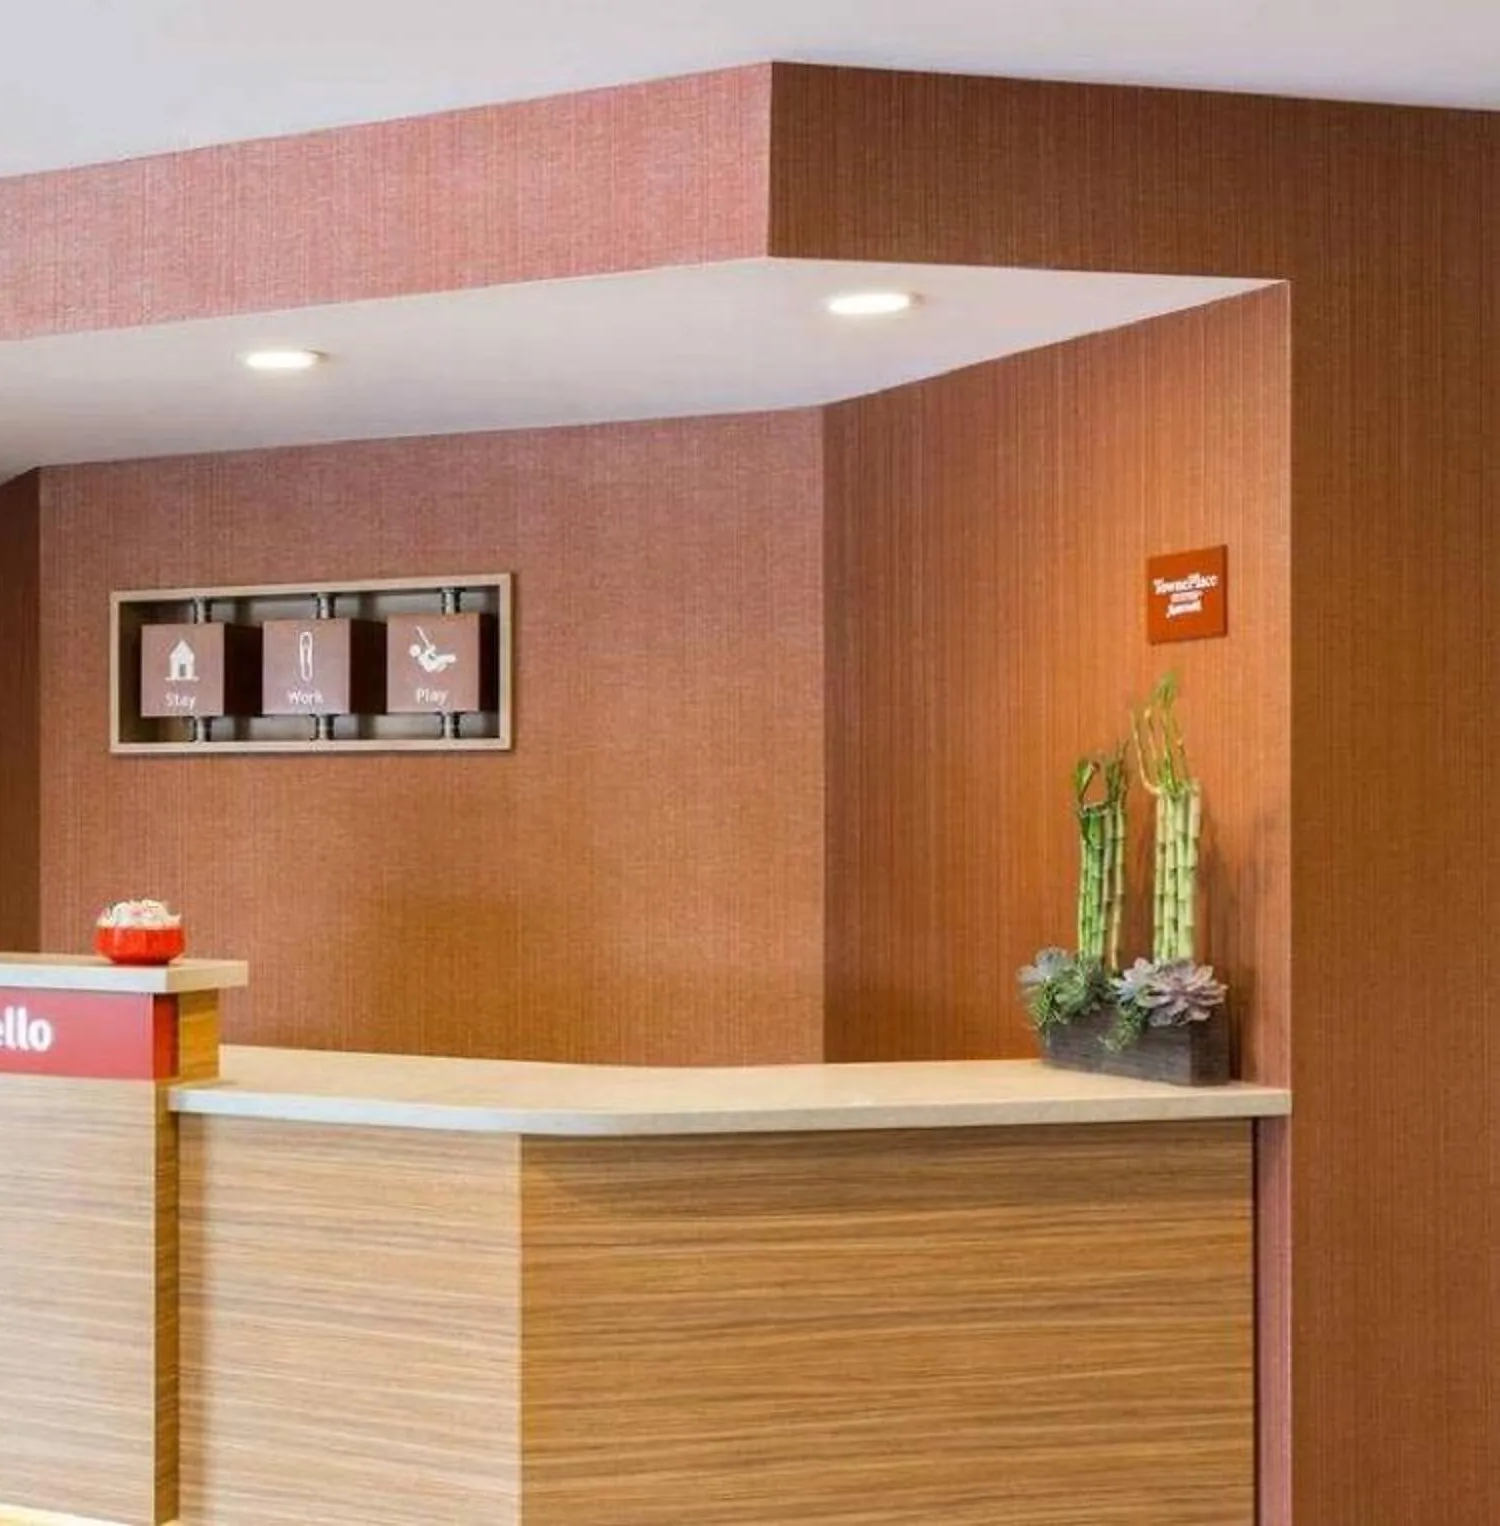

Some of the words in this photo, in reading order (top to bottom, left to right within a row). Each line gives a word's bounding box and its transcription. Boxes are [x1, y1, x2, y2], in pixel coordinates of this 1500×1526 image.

[164, 691, 197, 710] Stay
[287, 688, 324, 705] Work
[415, 687, 449, 707] Play
